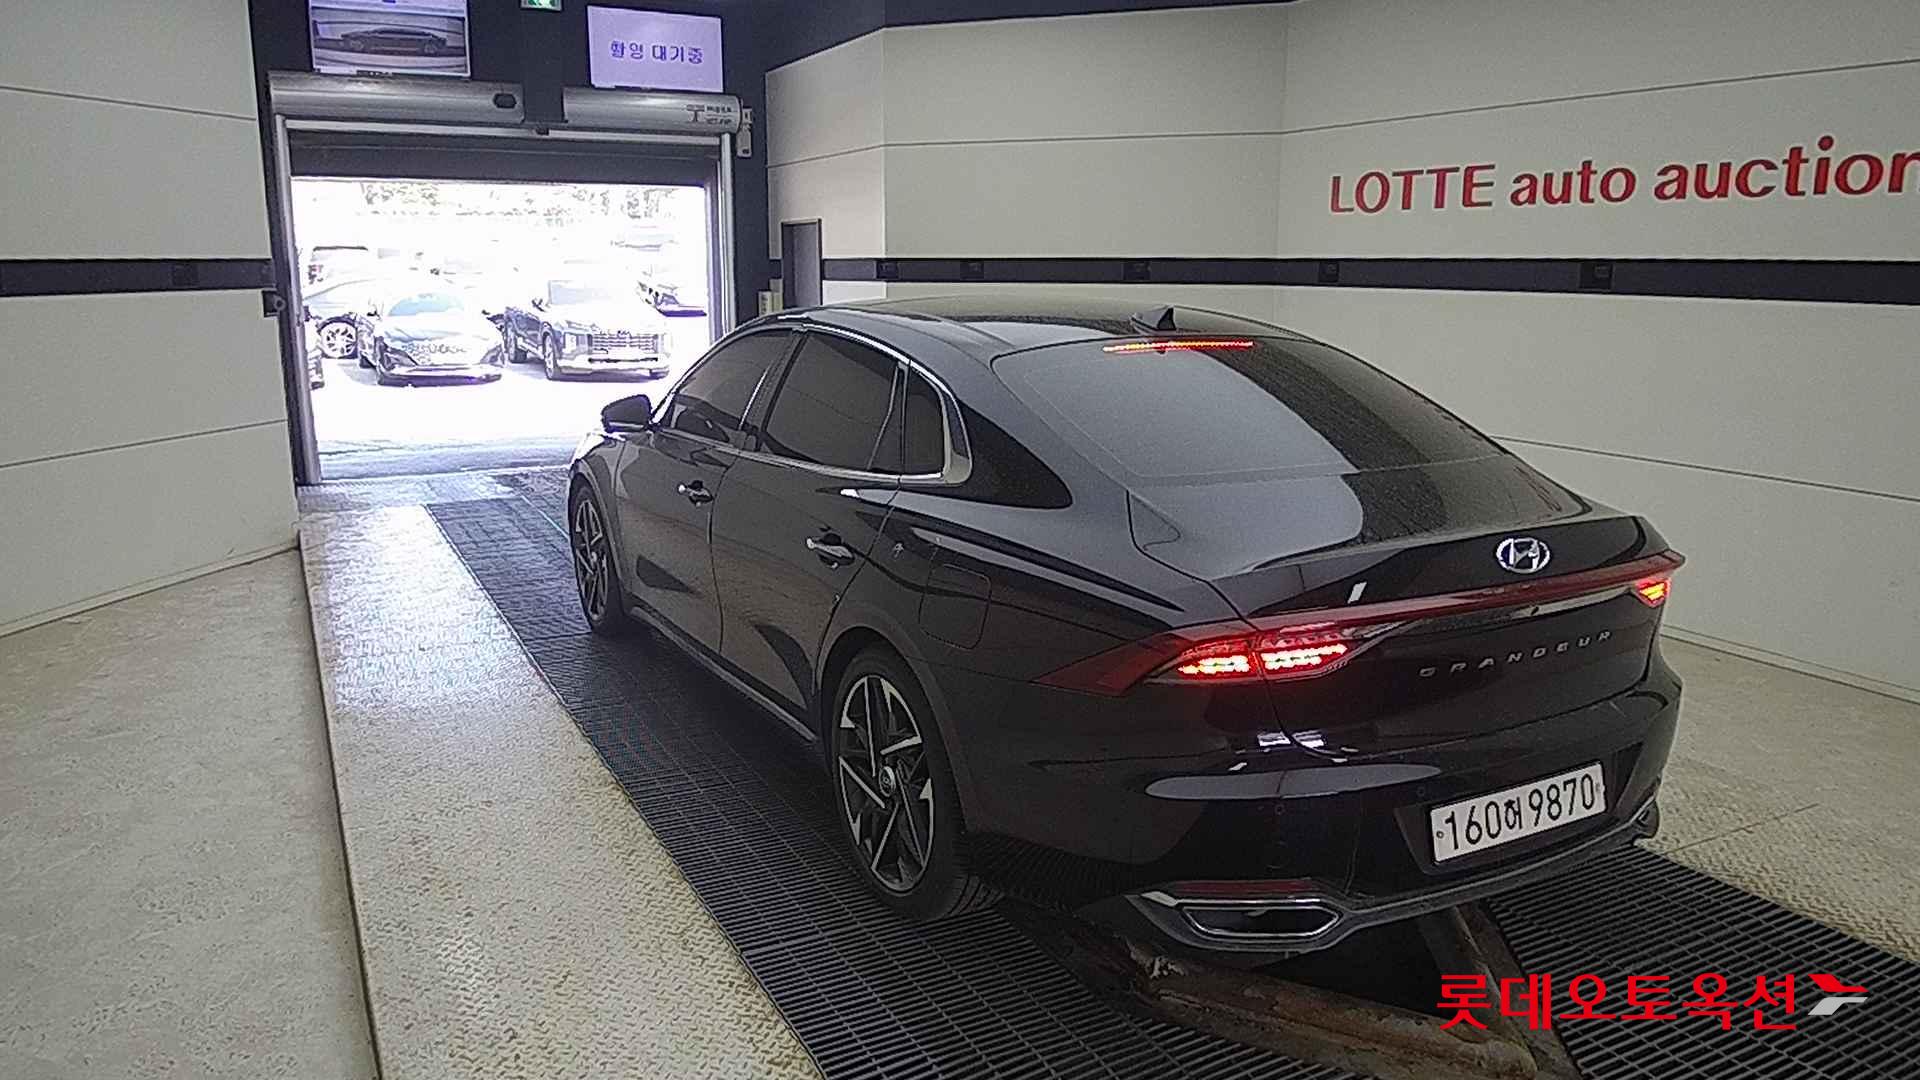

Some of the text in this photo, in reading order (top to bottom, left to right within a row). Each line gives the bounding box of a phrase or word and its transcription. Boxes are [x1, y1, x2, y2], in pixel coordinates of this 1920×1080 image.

[652, 44, 703, 65] 대기중
[1331, 164, 1496, 213] LOTTE
[1510, 159, 1637, 206] auto
[1419, 630, 1611, 677] GRANDEUR
